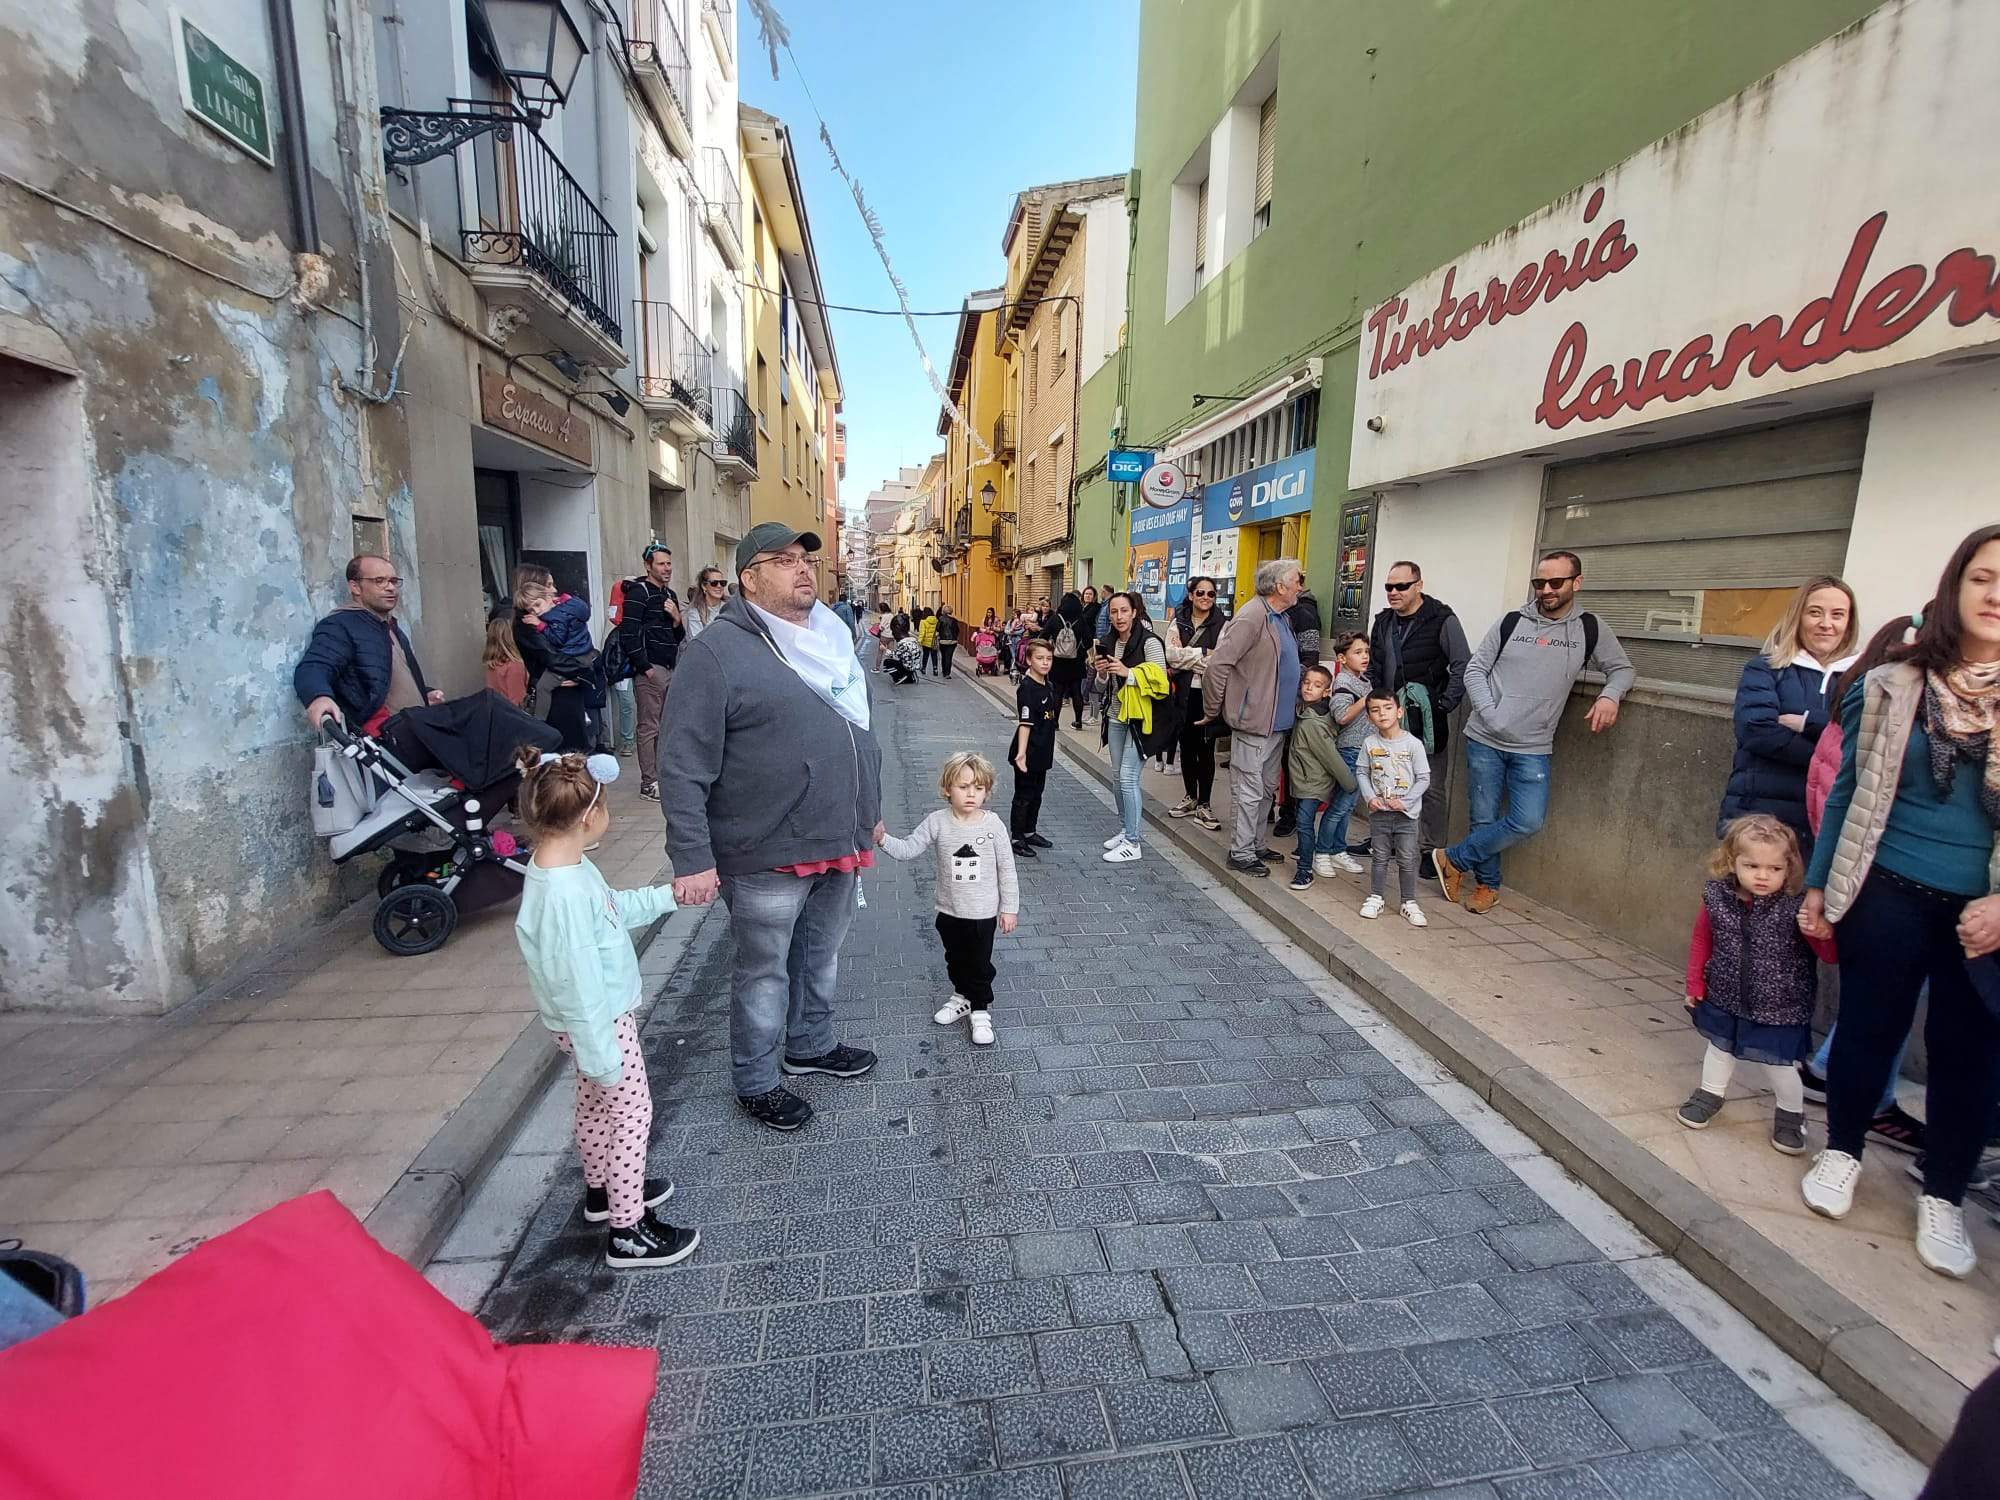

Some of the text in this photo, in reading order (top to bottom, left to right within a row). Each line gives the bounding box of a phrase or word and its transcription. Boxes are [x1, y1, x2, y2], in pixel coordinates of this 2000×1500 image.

[224, 64, 256, 102] Calle
[1535, 210, 2000, 430] lavander
[501, 383, 554, 435] Espacio
[1111, 463, 1143, 472] DIGI
[1250, 468, 1306, 508] DIGI
[1165, 510, 1176, 526] QUE
[1176, 507, 1188, 523] HAY
